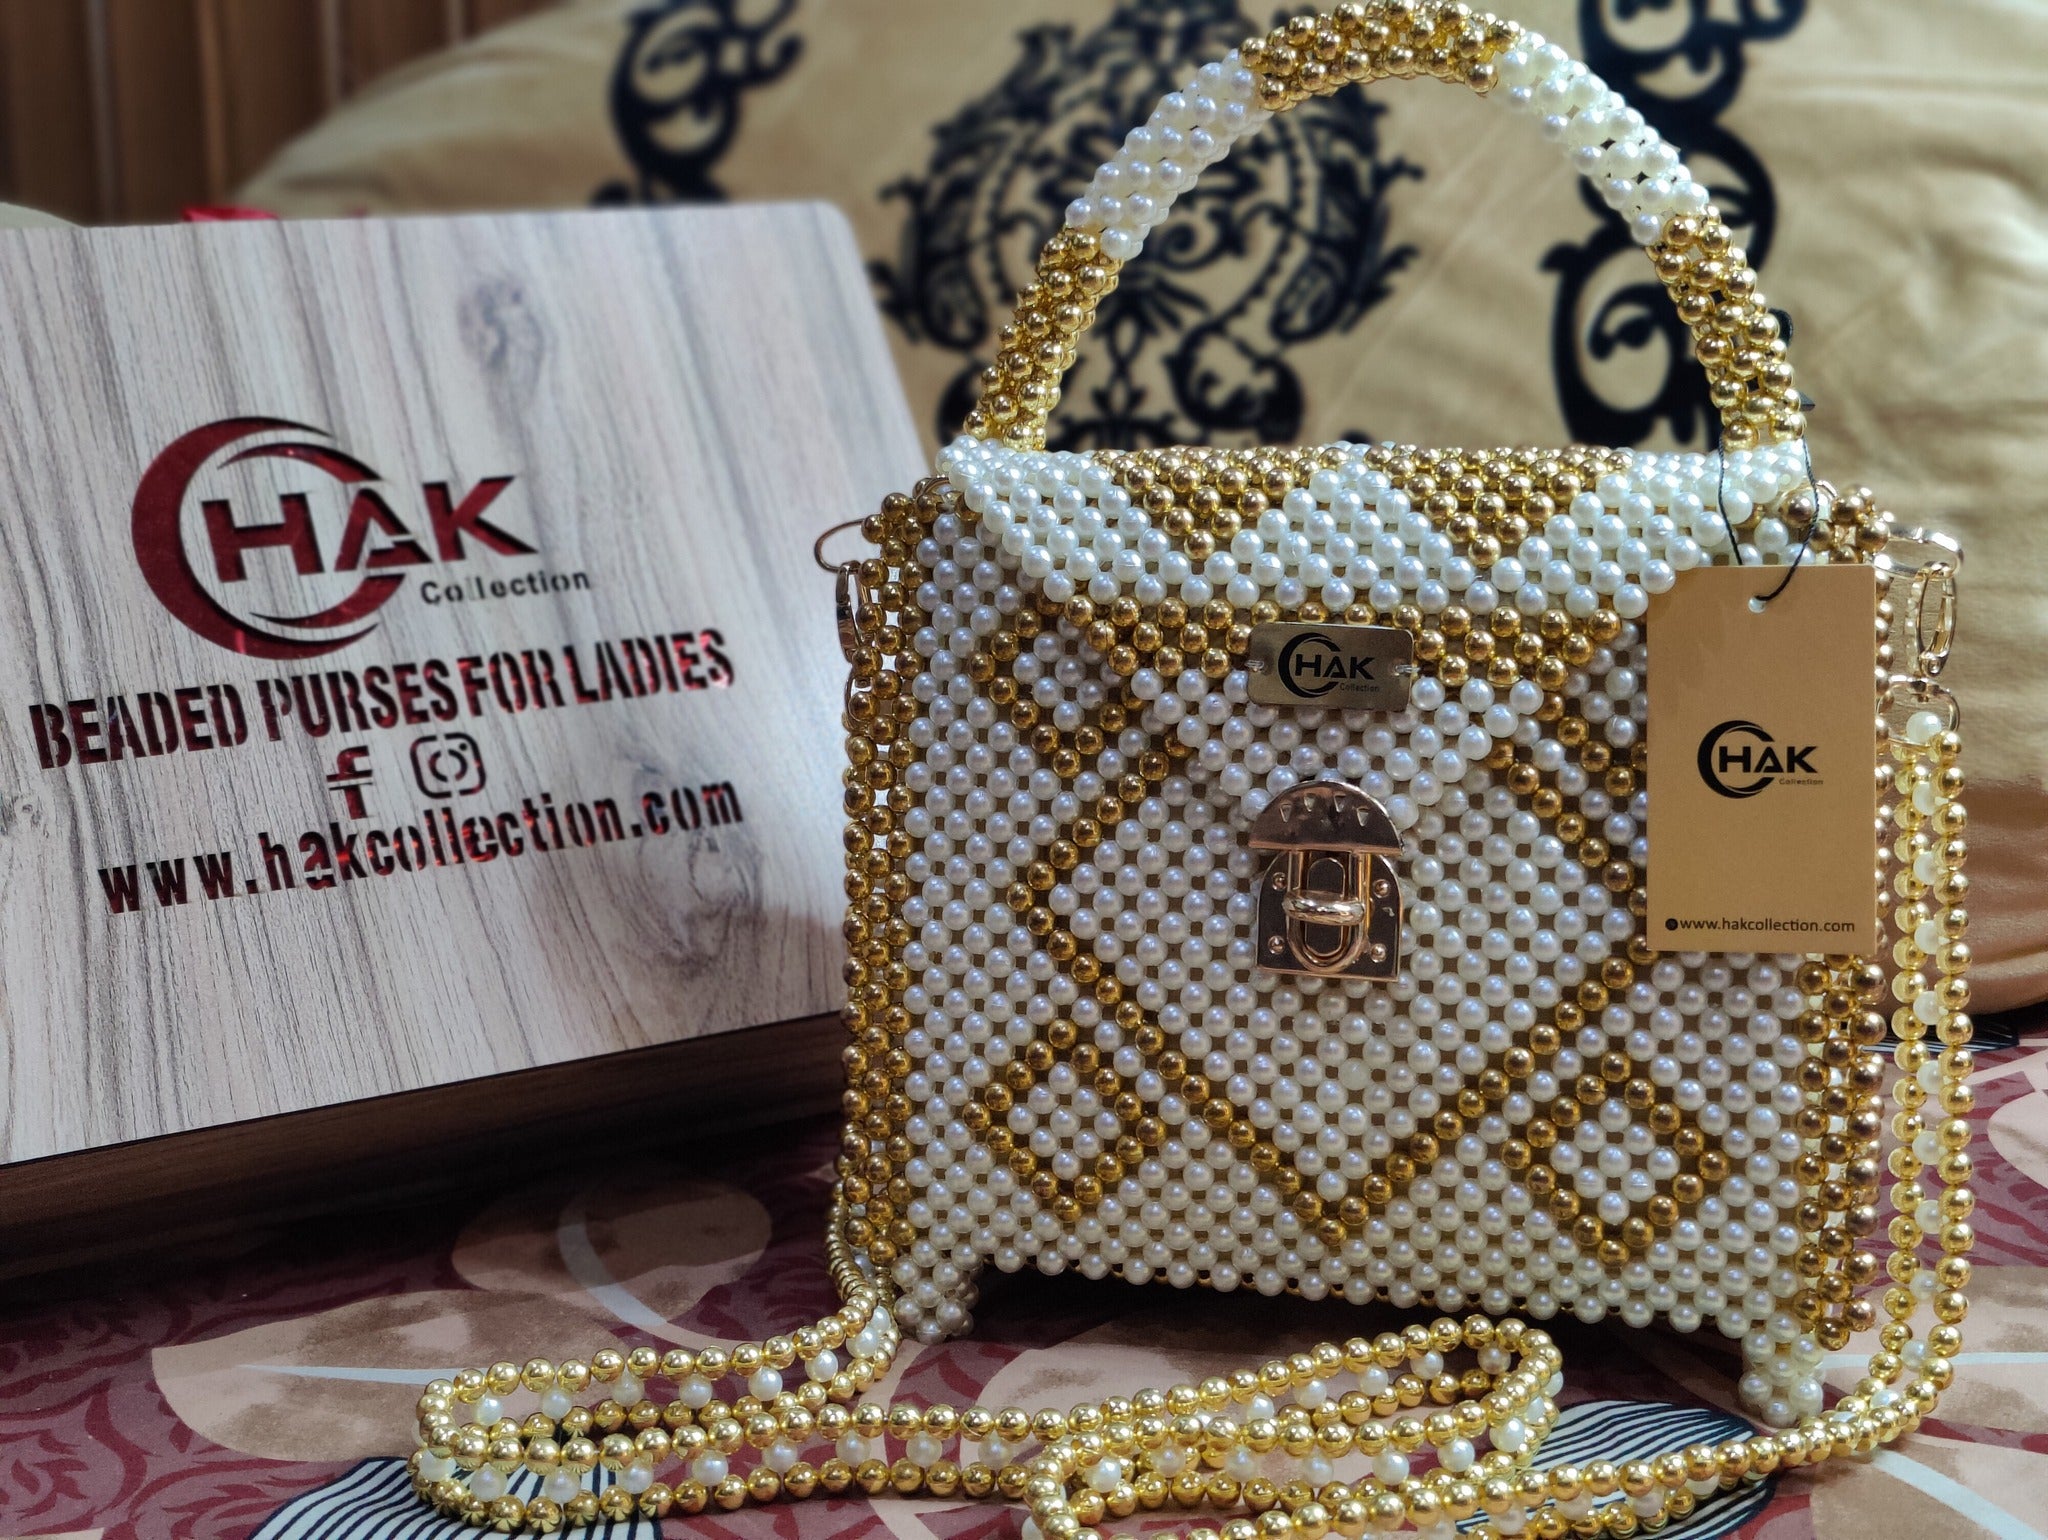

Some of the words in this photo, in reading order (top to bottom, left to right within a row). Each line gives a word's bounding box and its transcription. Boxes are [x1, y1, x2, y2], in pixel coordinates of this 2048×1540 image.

[28, 684, 249, 770] BEADED
[255, 658, 459, 742] PURSES
[457, 651, 566, 715] FOR
[563, 628, 735, 705] LADIES
[99, 780, 744, 914] www.hakcollection.com
[1679, 917, 1856, 933] www.hakcollection.com
